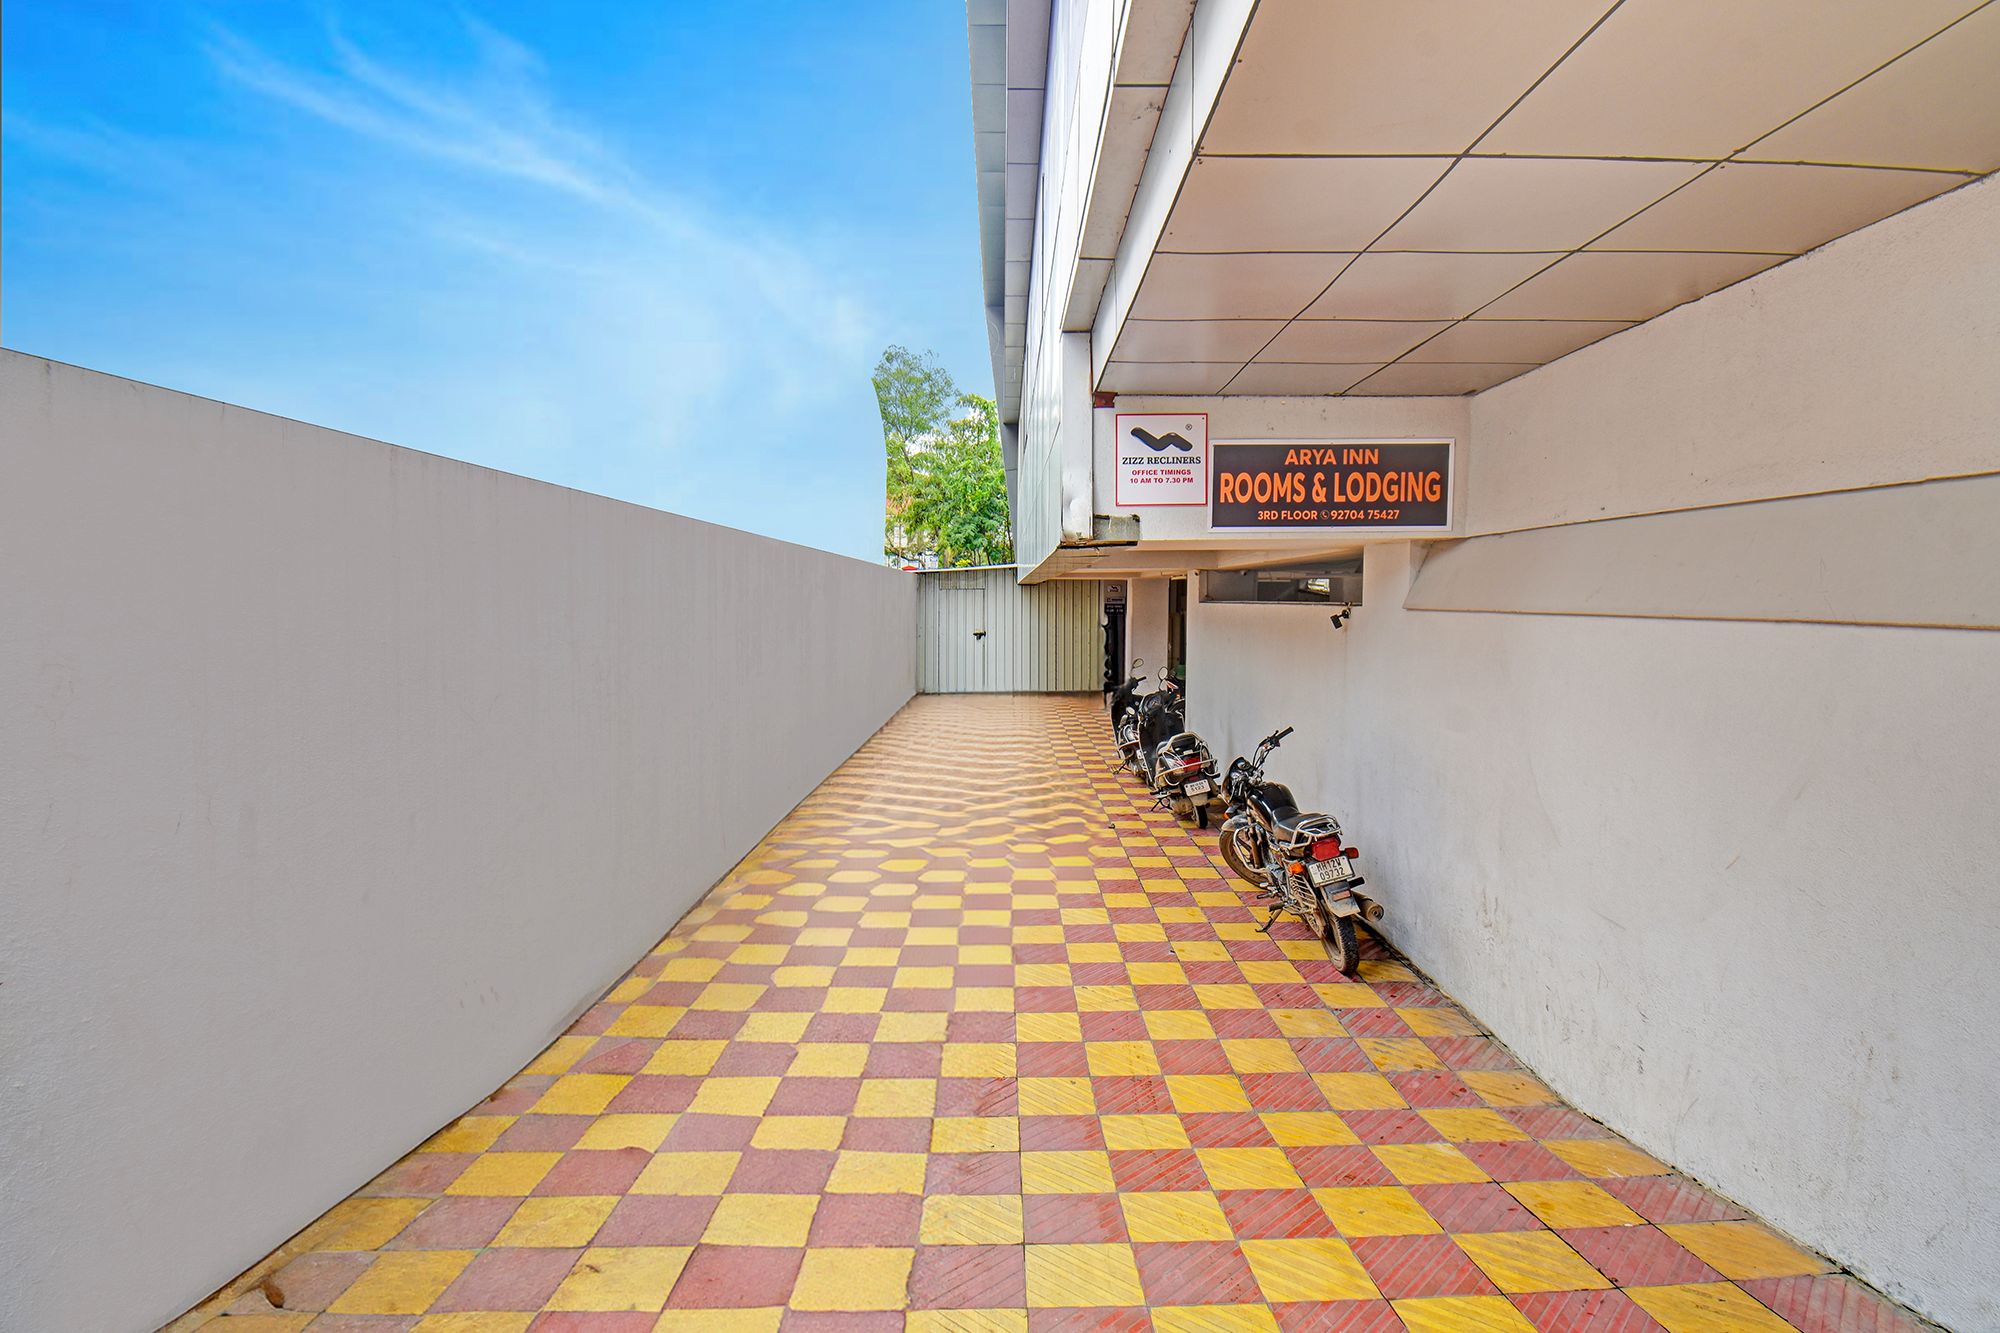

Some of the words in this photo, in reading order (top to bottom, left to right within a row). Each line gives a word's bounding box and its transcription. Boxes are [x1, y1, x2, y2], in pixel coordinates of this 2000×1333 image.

[1122, 456, 1145, 465] ZIZZ
[1147, 456, 1202, 465] RECLINERS
[1284, 448, 1337, 466] ARYA
[1343, 448, 1379, 465] INN
[1220, 471, 1306, 503] ROOMS
[1311, 471, 1327, 503] &
[1334, 471, 1441, 503] LODGING
[1257, 510, 1279, 520] 3RD
[1281, 510, 1318, 520] FLOOR
[1330, 509, 1365, 520] 92704
[1367, 509, 1400, 520] 75427
